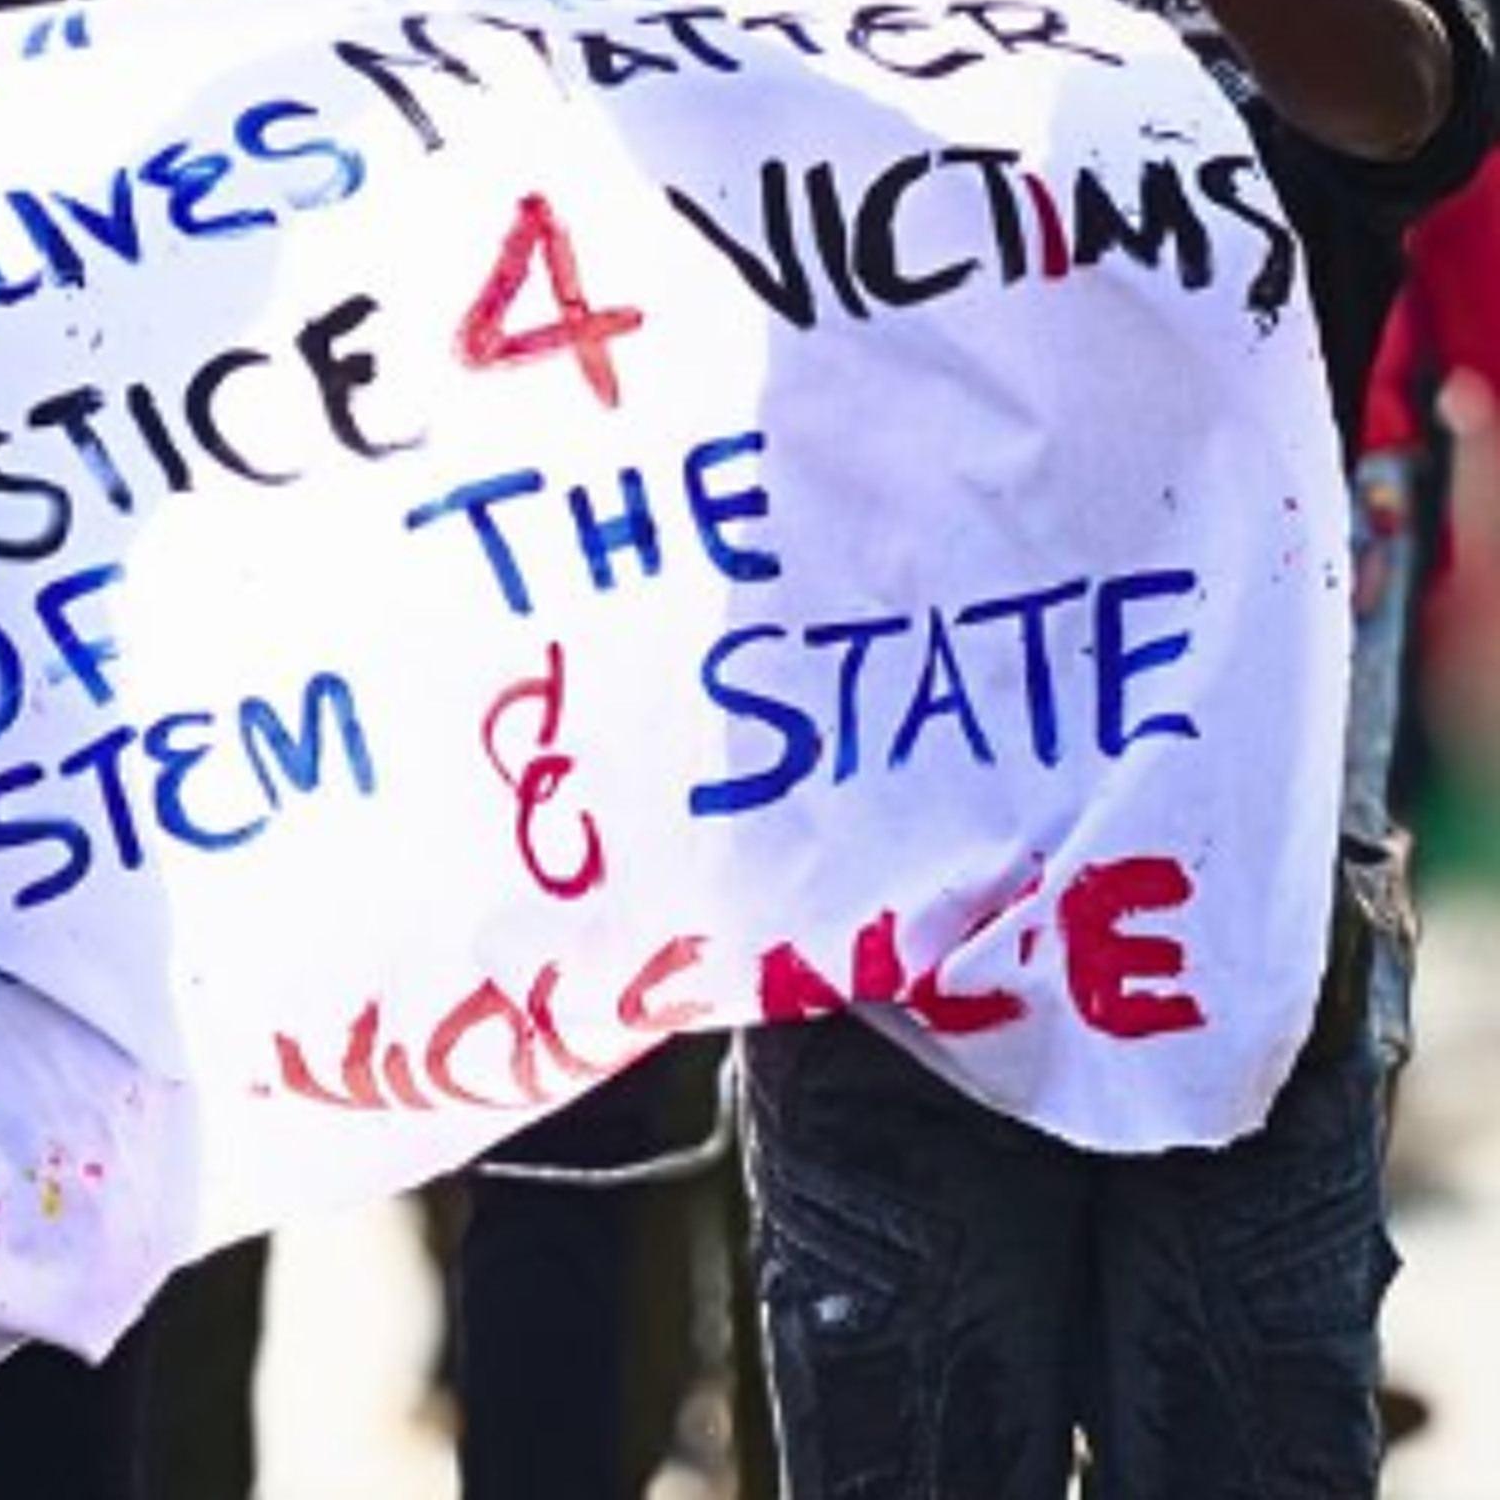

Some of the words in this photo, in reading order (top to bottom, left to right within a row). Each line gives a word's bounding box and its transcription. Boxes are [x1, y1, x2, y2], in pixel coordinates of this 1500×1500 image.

[454, 193, 645, 410] 4
[666, 146, 1297, 338] VICTIMS
[405, 431, 781, 615] THE
[690, 568, 1200, 816] STATE
